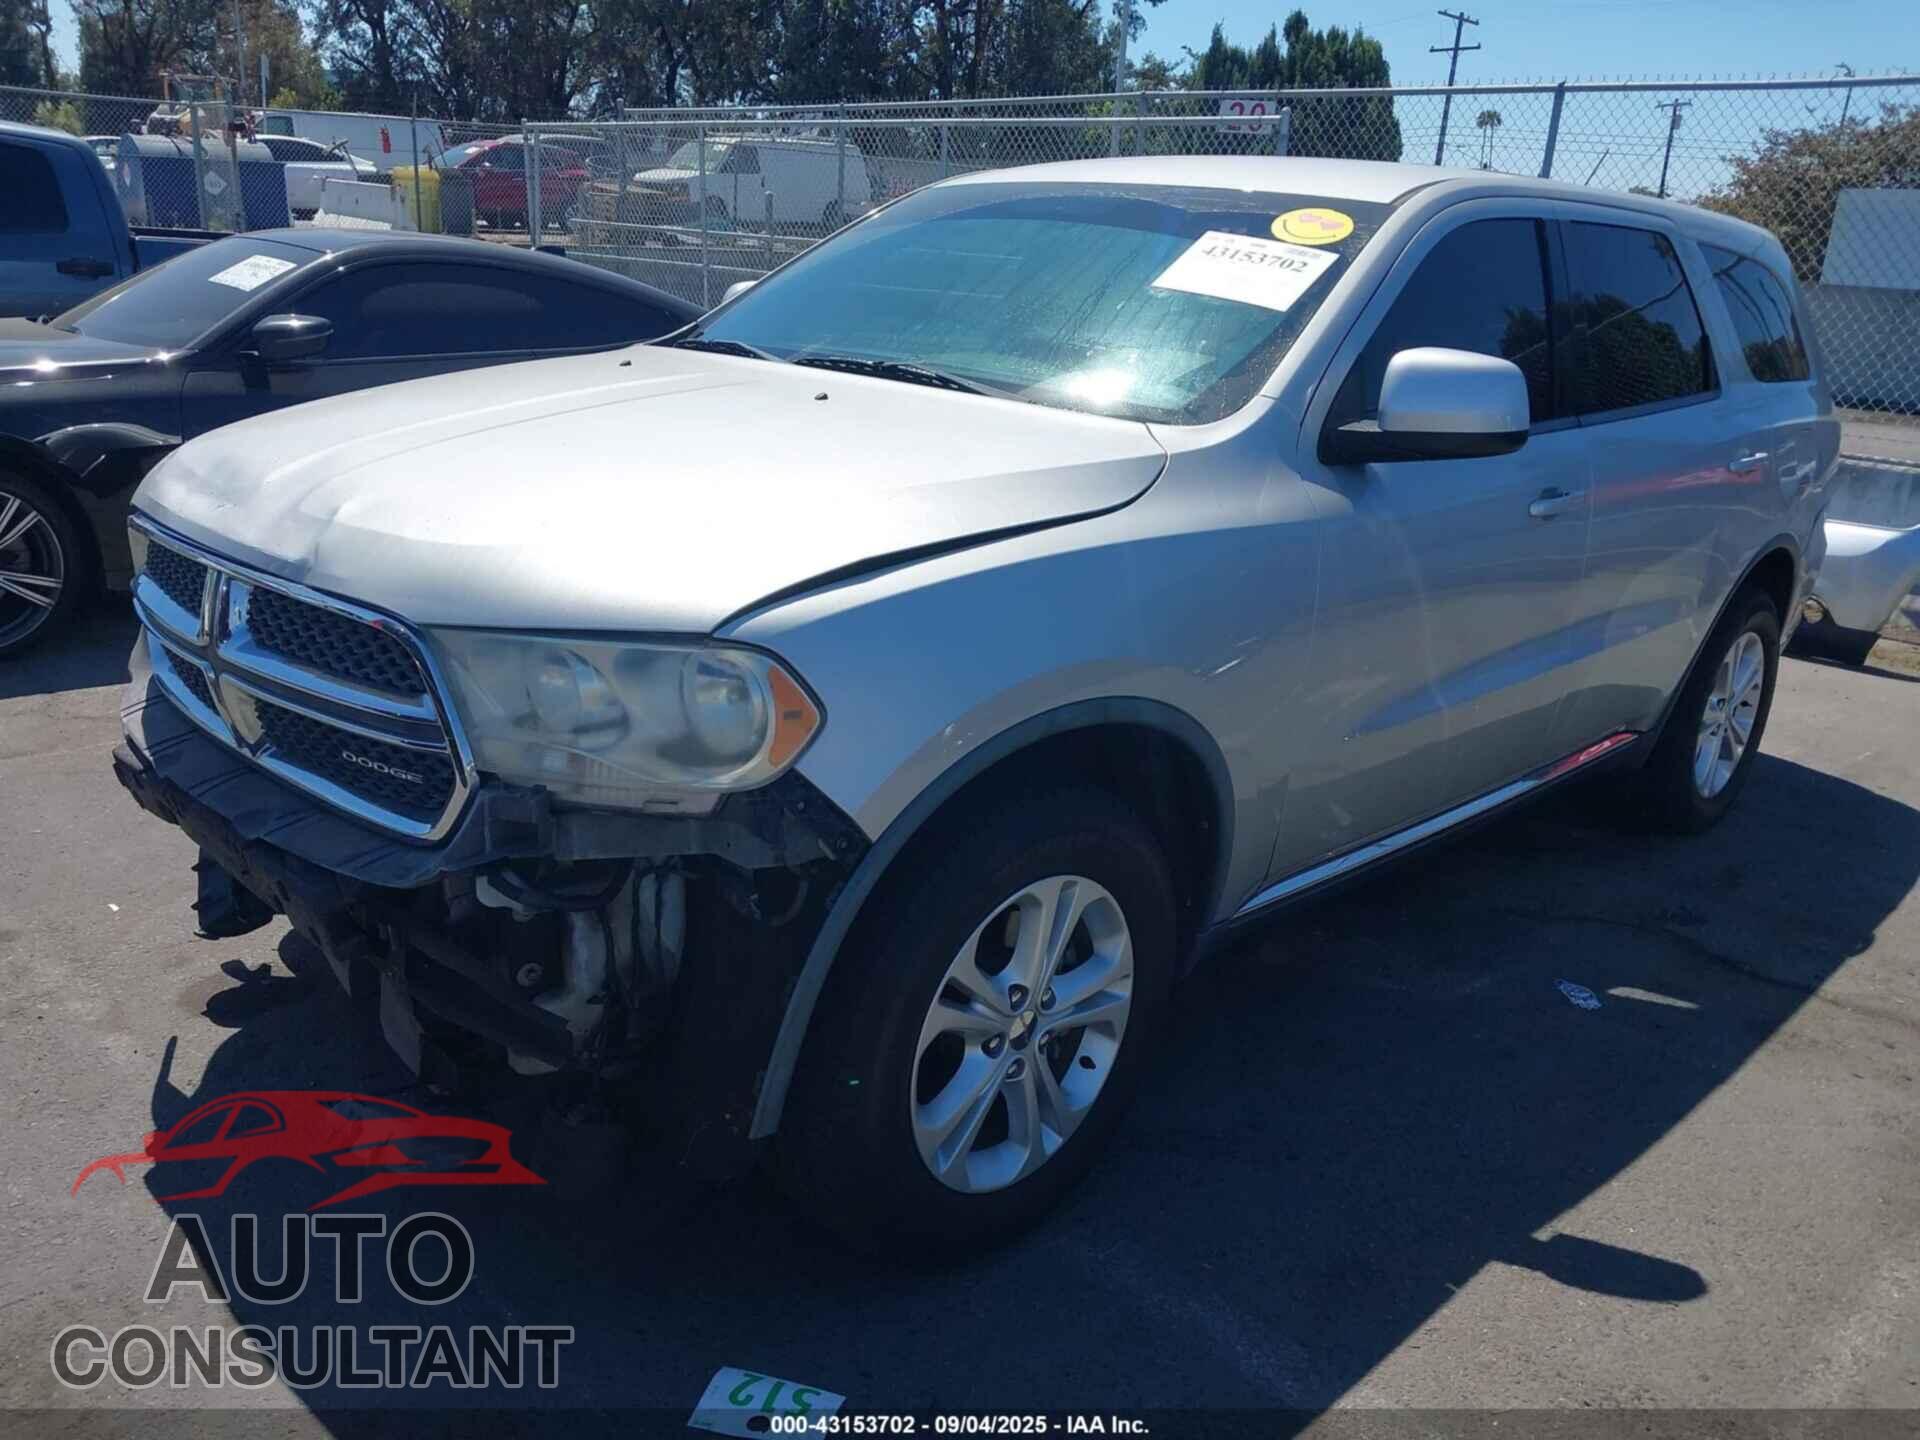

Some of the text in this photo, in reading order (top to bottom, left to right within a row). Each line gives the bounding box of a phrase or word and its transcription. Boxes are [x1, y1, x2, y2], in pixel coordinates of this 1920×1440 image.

[1201, 245, 1309, 273] 43153702
[342, 751, 424, 784] DODGE
[728, 1373, 821, 1416] 512
